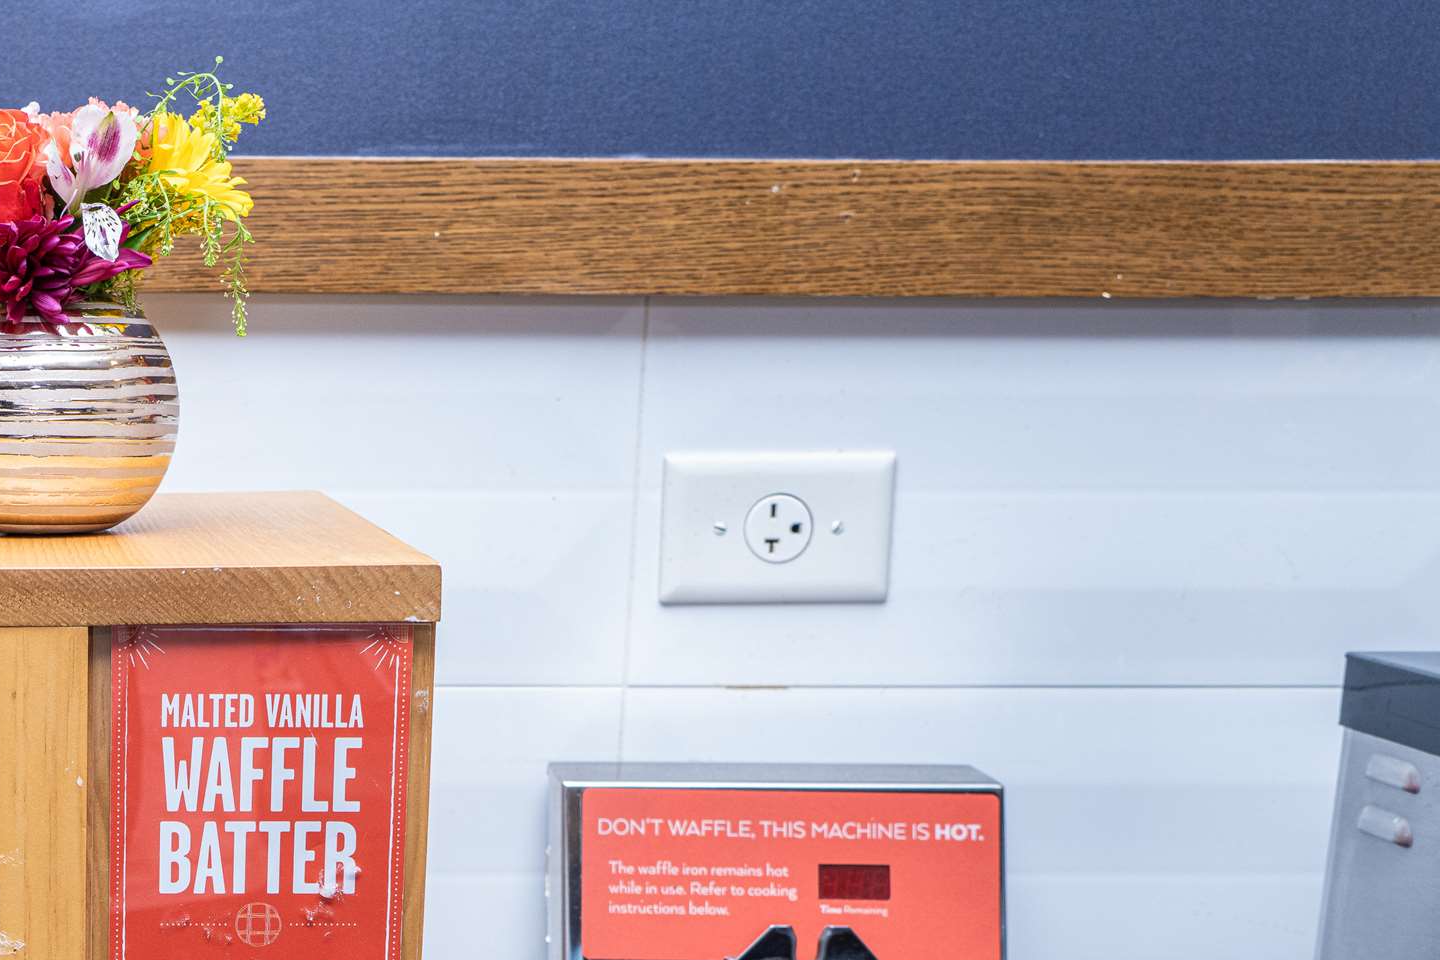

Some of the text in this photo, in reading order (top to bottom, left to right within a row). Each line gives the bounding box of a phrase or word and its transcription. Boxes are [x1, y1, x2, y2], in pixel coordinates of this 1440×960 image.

[161, 694, 364, 729] MALTED VANILLA
[162, 737, 363, 812] WAFFLE
[598, 818, 984, 841] DON'T WAFFLE, THIS MACHINE IS HOT.
[159, 821, 356, 895] BATTER
[609, 860, 789, 877] The waffle iron remains hot
[609, 881, 797, 901] while in use. Refer to cooking
[609, 900, 730, 916] instructions below.
[844, 904, 888, 917] Remaining
